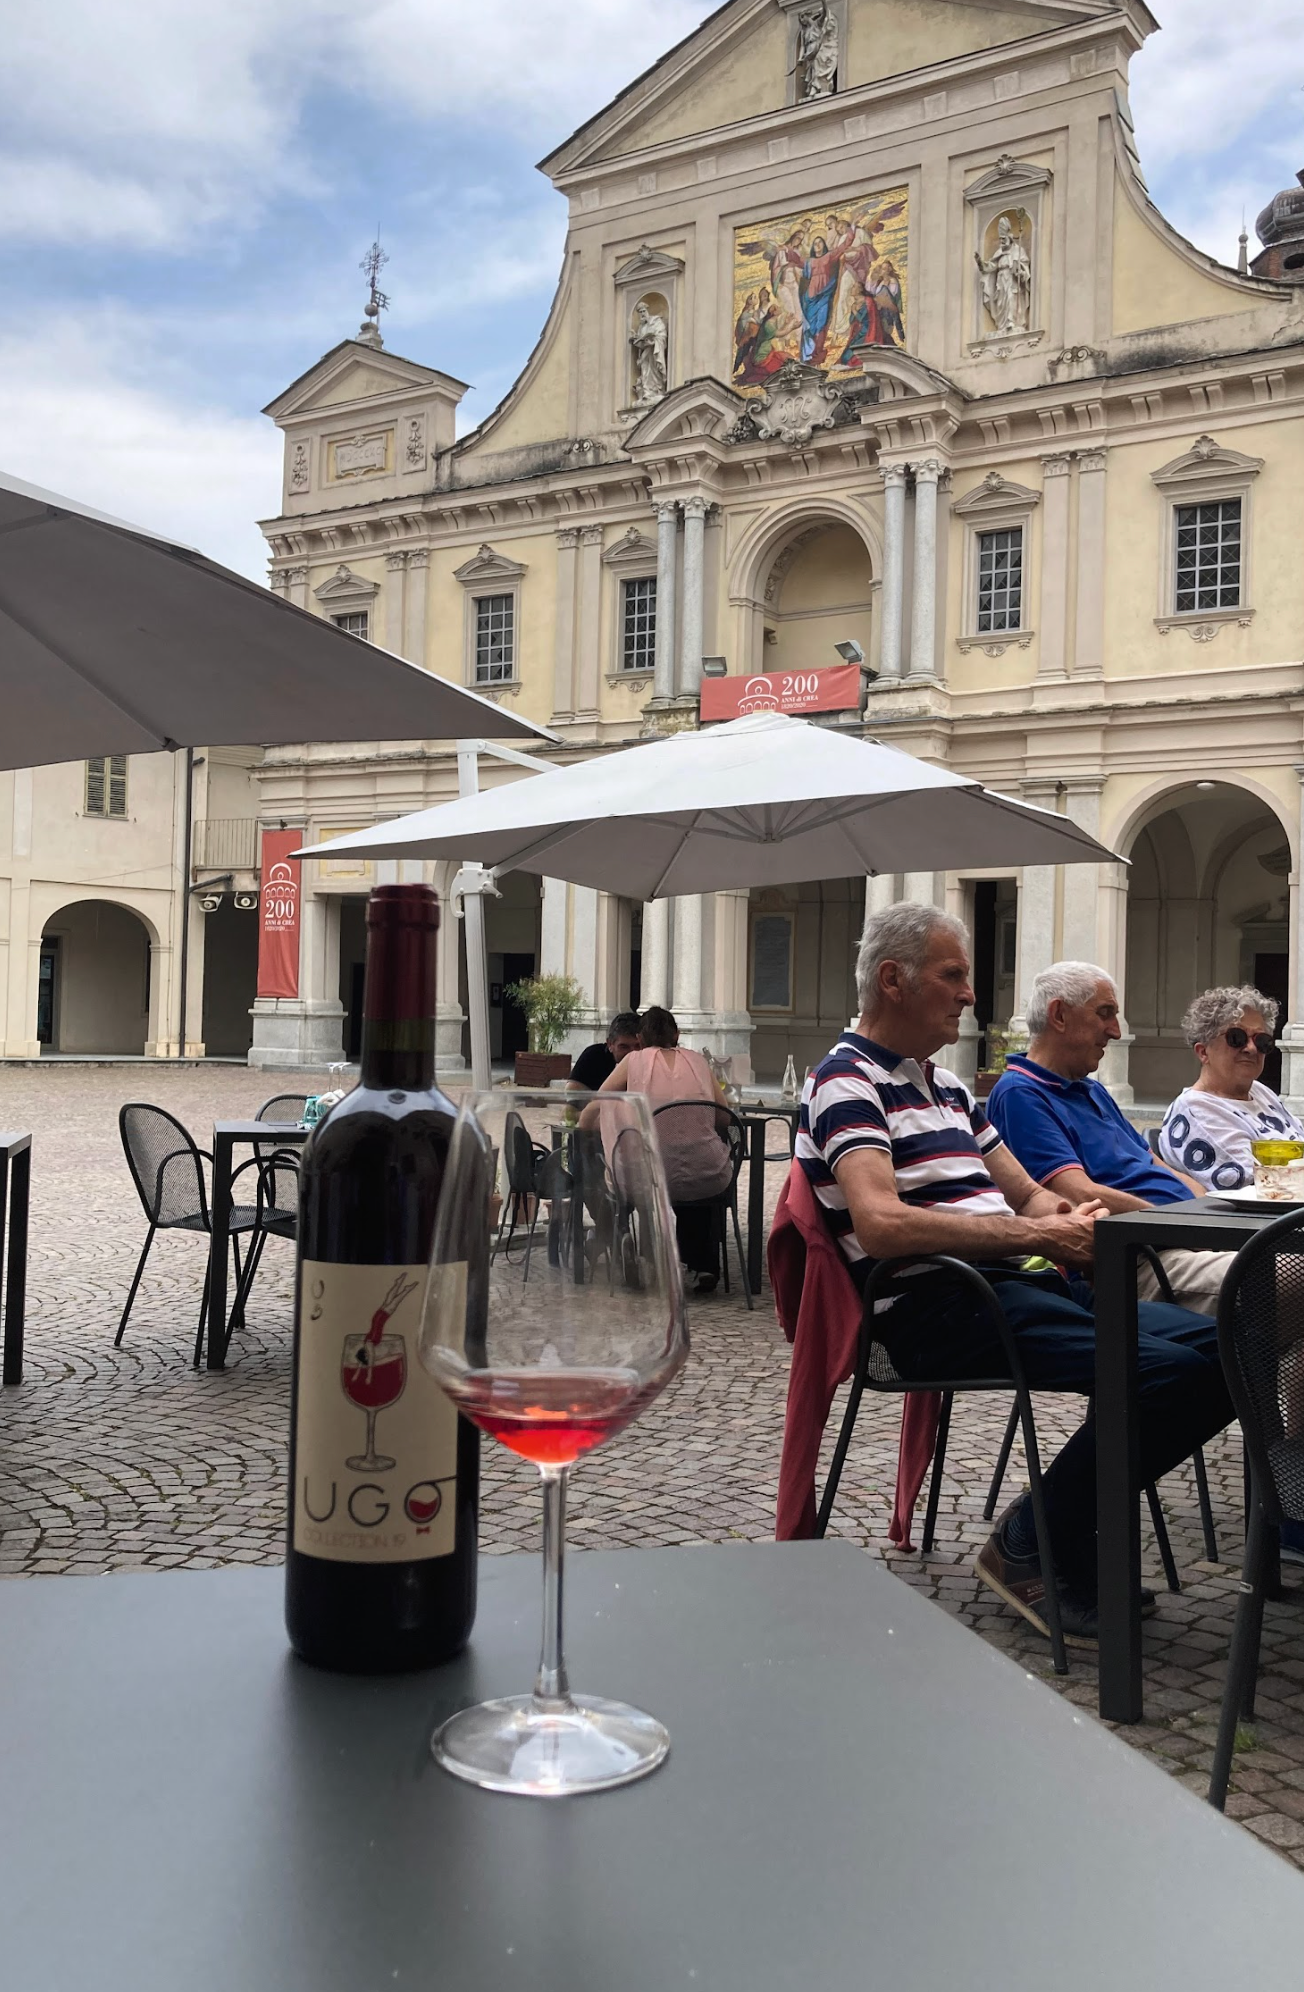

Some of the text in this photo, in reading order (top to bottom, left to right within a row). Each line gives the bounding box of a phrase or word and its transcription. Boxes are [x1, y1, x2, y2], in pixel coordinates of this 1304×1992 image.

[781, 673, 819, 696] 200
[802, 694, 819, 702] CREA
[264, 899, 295, 919] 200
[304, 1475, 457, 1528] UGO
